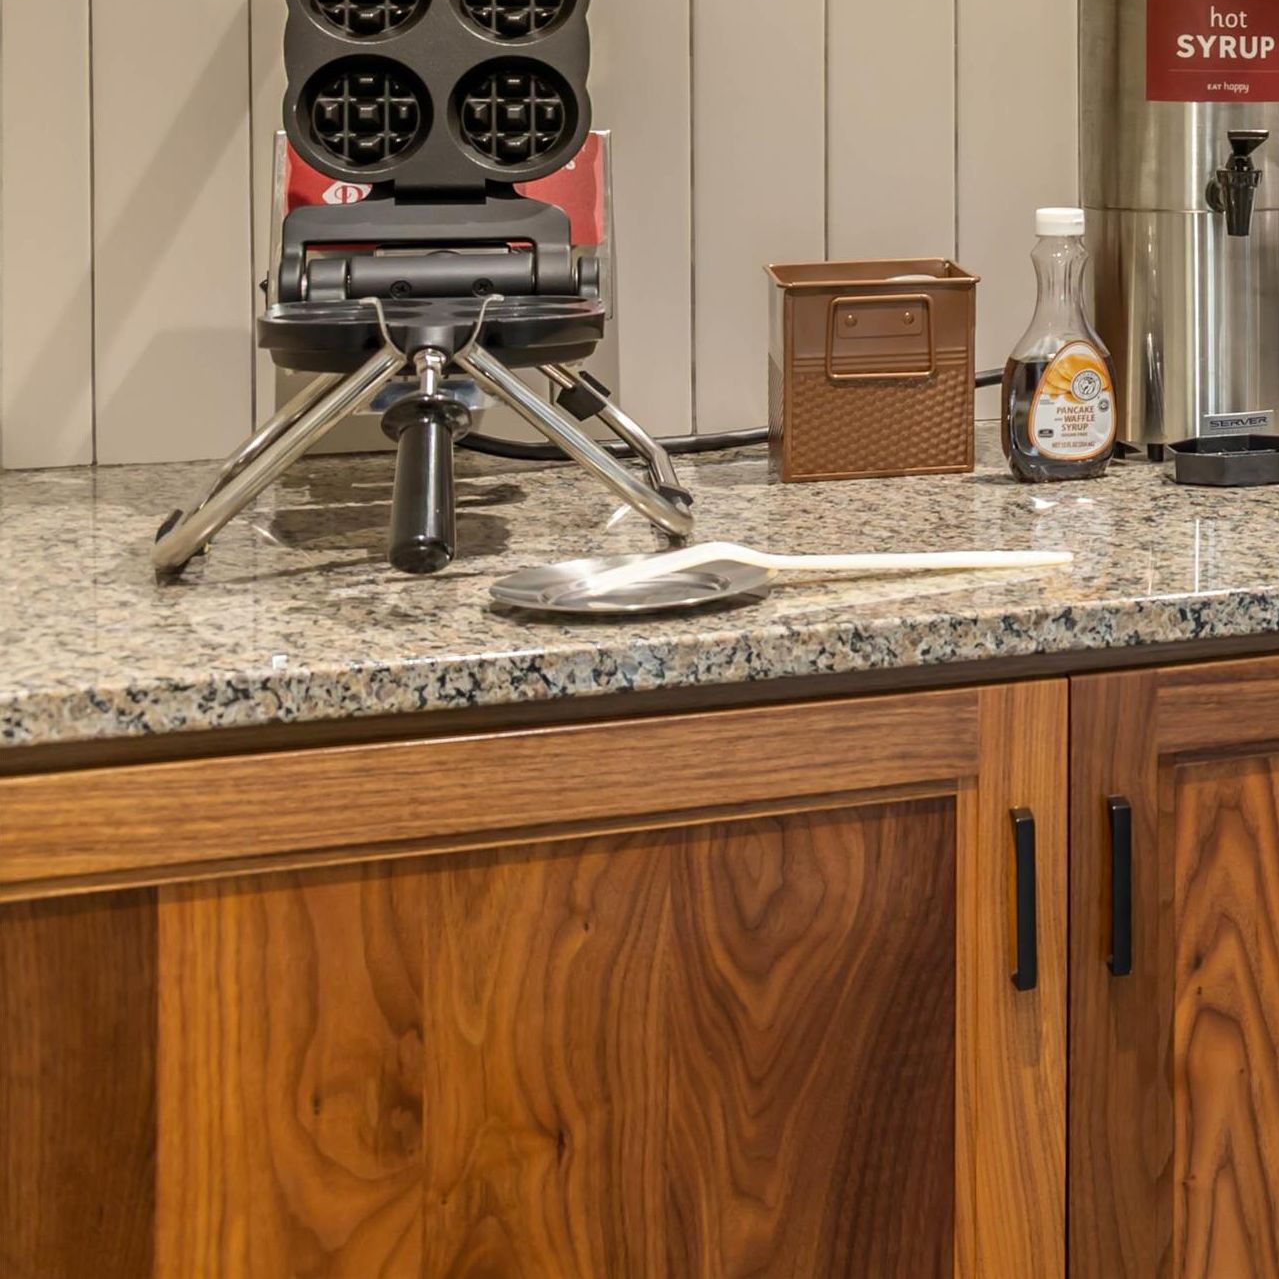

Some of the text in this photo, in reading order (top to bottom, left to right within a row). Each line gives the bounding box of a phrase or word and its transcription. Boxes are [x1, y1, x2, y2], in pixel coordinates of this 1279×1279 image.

[1210, 5, 1248, 29] hot
[1175, 33, 1275, 60] SYRUP
[1223, 81, 1250, 93] happy
[1056, 405, 1095, 414] PANCAKE
[1064, 414, 1096, 423] WAFFLE
[1209, 416, 1267, 427] SERVER
[1061, 423, 1089, 431] SYRUP
